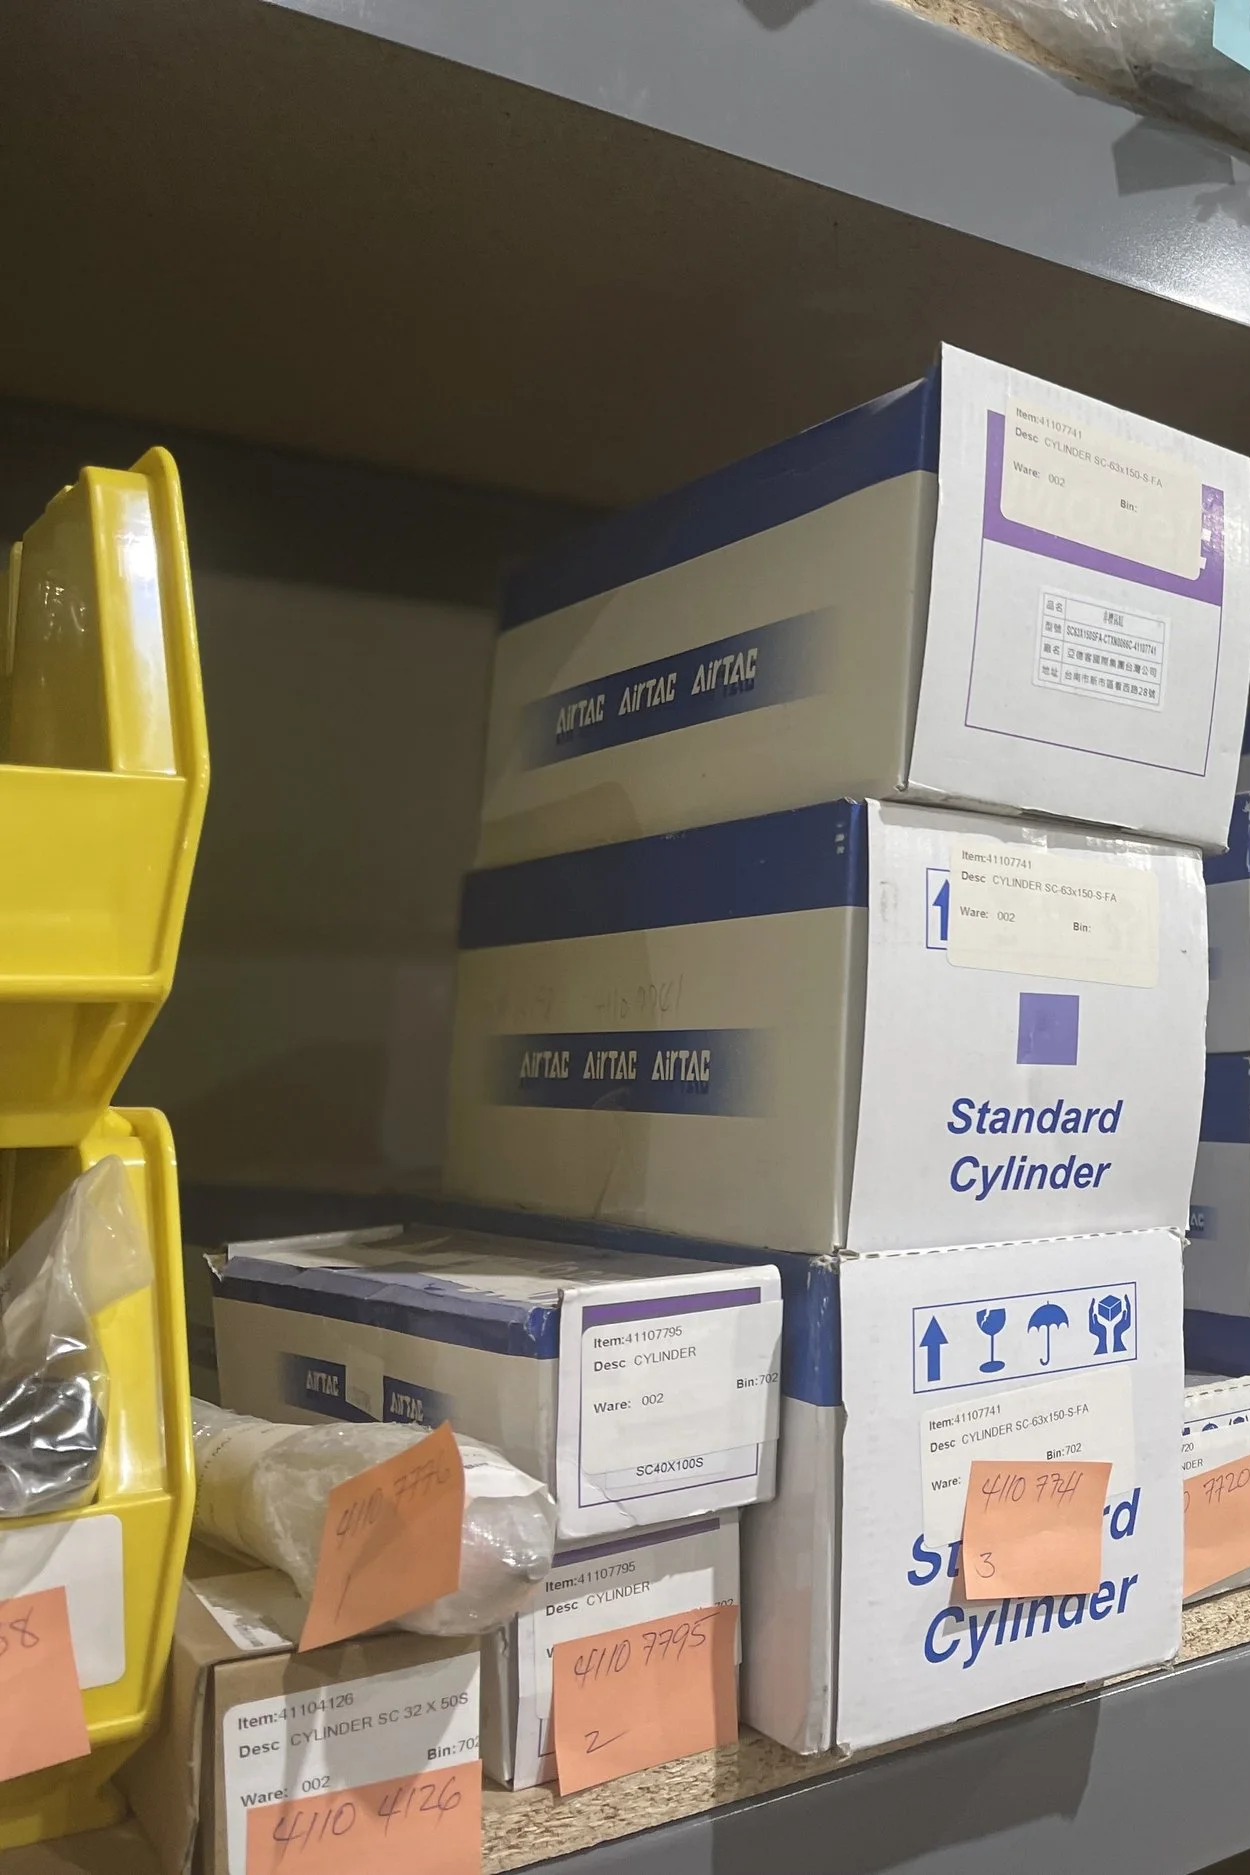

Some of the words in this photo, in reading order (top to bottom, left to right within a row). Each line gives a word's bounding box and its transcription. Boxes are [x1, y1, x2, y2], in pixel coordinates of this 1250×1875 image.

[1015, 427, 1039, 443] Desc
[1044, 437, 1092, 462] CYLINDER
[1013, 460, 1041, 479] Ware:
[1048, 473, 1066, 488] 002
[1120, 498, 1138, 513] Bin:
[961, 871, 986, 884] Desc
[992, 875, 1042, 891] CYLINDER
[959, 906, 989, 919] Ware:
[997, 910, 1016, 922] 002
[1073, 921, 1092, 933] Bin:
[947, 1097, 1124, 1134] Standard
[950, 1155, 1112, 1201] Cylinder
[593, 1325, 683, 1349] Item:41107795
[593, 1358, 626, 1372] Desc
[633, 1346, 697, 1366] CYLINDER
[593, 1401, 632, 1414] Ware:
[641, 1392, 664, 1406] 002
[929, 1438, 956, 1453] Desc
[961, 1423, 1013, 1446] CYLINDER
[1015, 1403, 1089, 1432] SC-63x150-S-FA
[636, 1457, 704, 1477] SC40X100S
[931, 1476, 962, 1492] Ware:
[982, 1473, 1026, 1512] 4110
[1203, 1468, 1250, 1504] 7720
[545, 1560, 636, 1593] Item:41107795
[975, 1552, 996, 1578] 3
[545, 1601, 579, 1617] Desc
[586, 1580, 651, 1606] CYLINDER
[924, 1574, 1139, 1669] Cylinder
[573, 1639, 631, 1688] 4110
[642, 1612, 720, 1665] 7795
[238, 1740, 281, 1759] Desc
[290, 1715, 373, 1747] CYLINDER
[378, 1709, 400, 1727] SC
[403, 1703, 422, 1720] 32
[426, 1699, 437, 1713] X
[441, 1691, 469, 1711] 50S
[584, 1730, 630, 1754] 2
[240, 1787, 289, 1808] Ware:
[301, 1775, 331, 1793] 002
[272, 1801, 356, 1862] 4110
[377, 1775, 462, 1837] 4126
